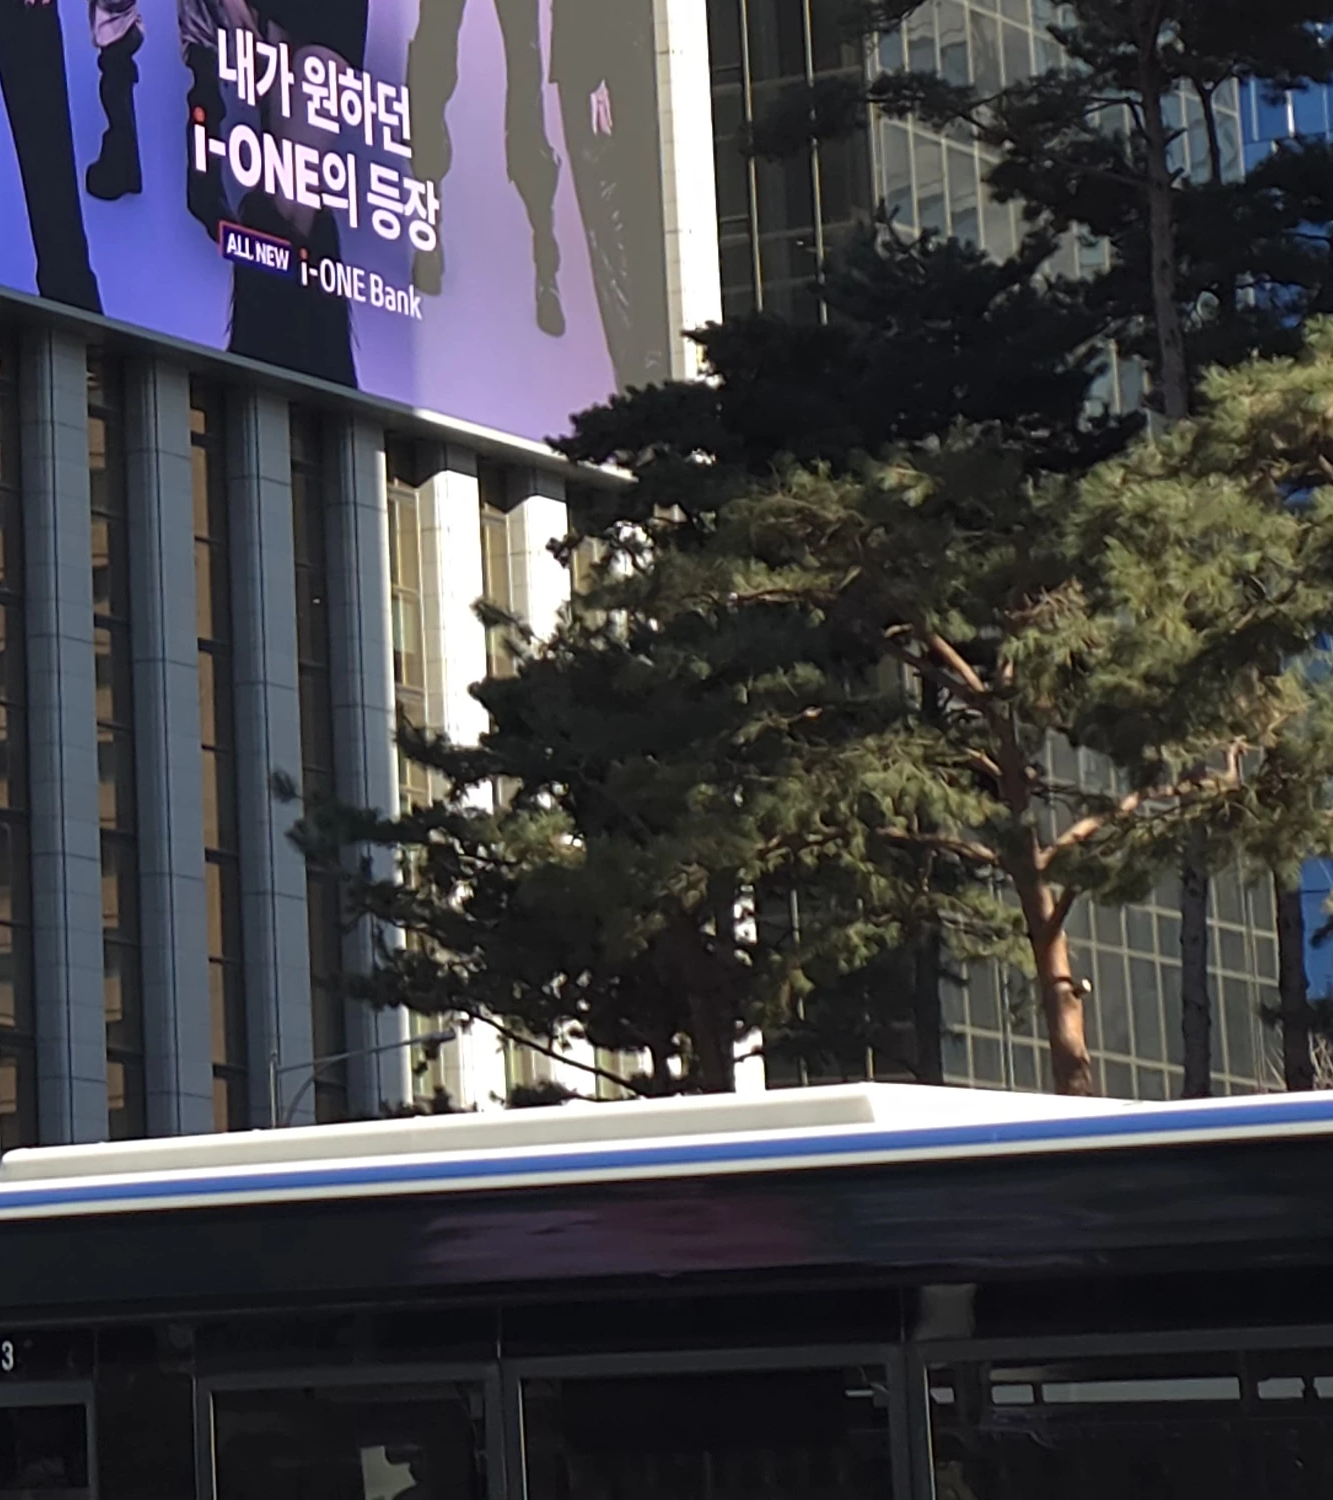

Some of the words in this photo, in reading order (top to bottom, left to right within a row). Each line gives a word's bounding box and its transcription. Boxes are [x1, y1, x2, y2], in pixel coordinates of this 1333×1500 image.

[217, 28, 295, 118] 내가
[302, 56, 412, 159] 원하던
[193, 106, 358, 229] i-ONE의
[367, 162, 440, 251] 등장
[227, 232, 254, 261] ALL
[255, 241, 290, 272] NEW
[300, 248, 367, 302] i-ONE
[369, 272, 423, 320] Bank
